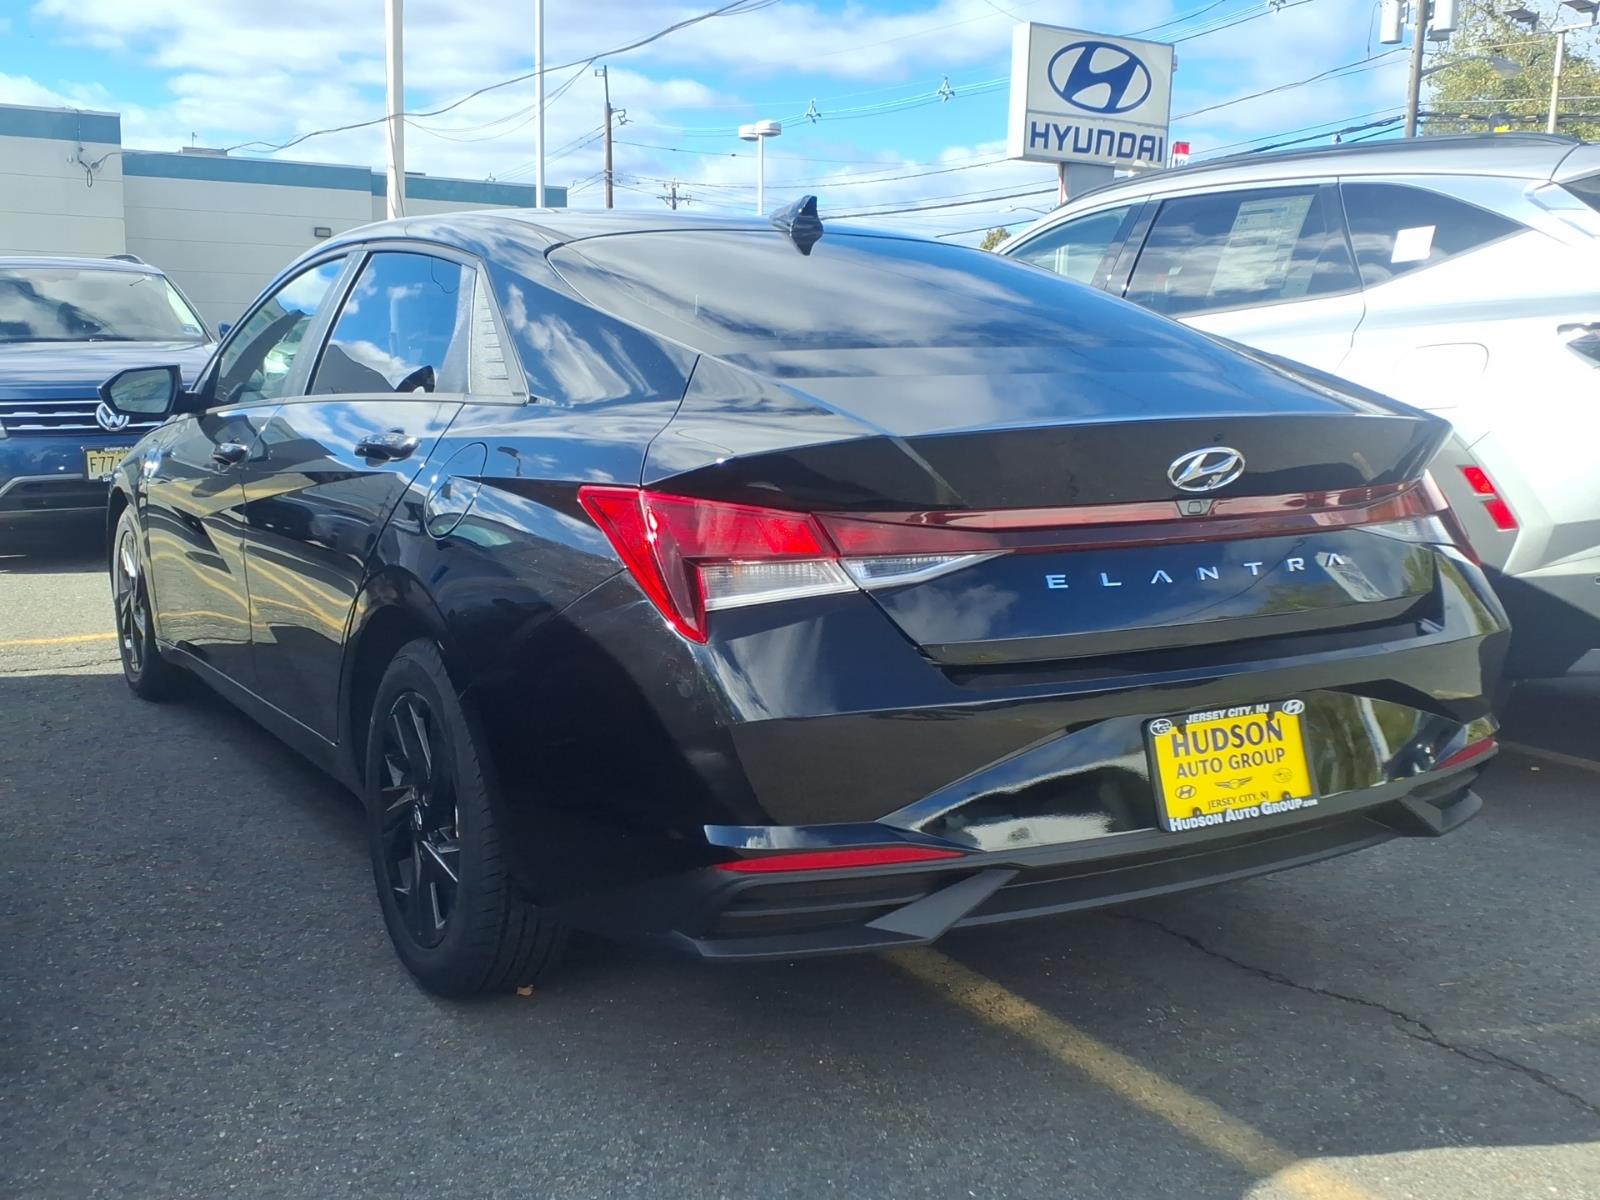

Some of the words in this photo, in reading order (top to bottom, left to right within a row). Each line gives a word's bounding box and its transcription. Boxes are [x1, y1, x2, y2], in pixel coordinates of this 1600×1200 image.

[1029, 121, 1163, 163] HYUNDAI
[1045, 552, 1346, 590] ELANTRA
[1186, 709, 1226, 724] JERSEY
[1256, 703, 1270, 714] NJ
[1172, 718, 1284, 758] HUDSON
[1176, 757, 1223, 779] AUTO
[1229, 747, 1286, 770] GROUP
[1208, 797, 1237, 809] JERSEY
[1260, 791, 1270, 800] NJ
[1169, 813, 1224, 832] HUDSON
[1225, 806, 1261, 822] AUTO
